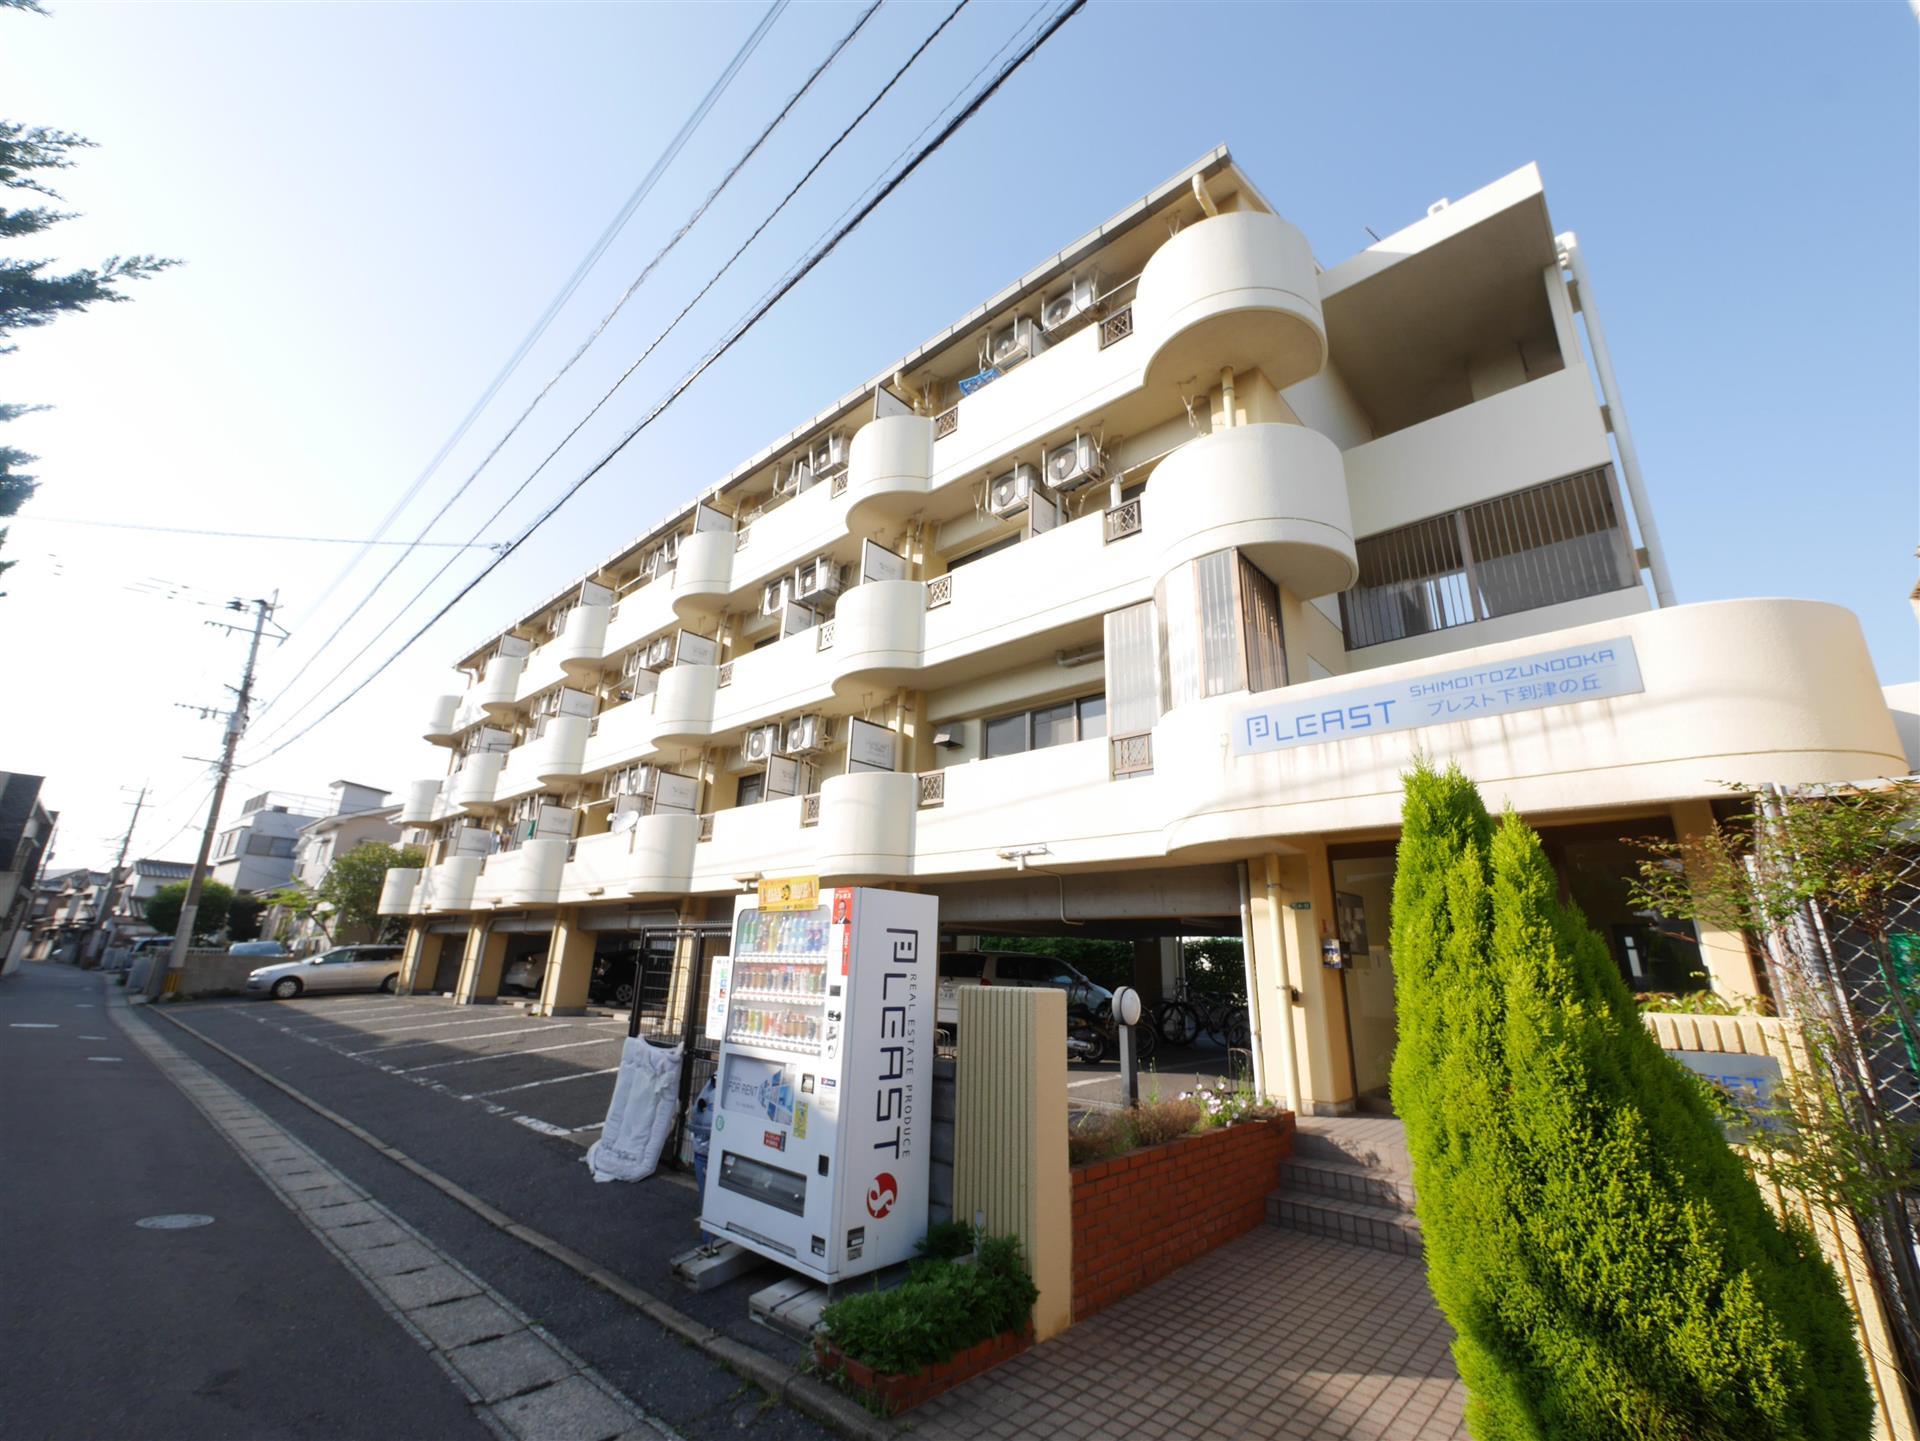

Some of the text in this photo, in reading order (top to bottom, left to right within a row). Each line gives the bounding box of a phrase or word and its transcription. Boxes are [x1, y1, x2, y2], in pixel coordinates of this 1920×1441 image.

[1409, 648, 1615, 698] SHIMOITOZUNOOKA
[1246, 700, 1396, 746] PLEAST
[874, 928, 918, 1160] PLEAST
[902, 973, 917, 1158] REAL ESTATE PRODUCE
[728, 1080, 759, 1098] FOR RENT
